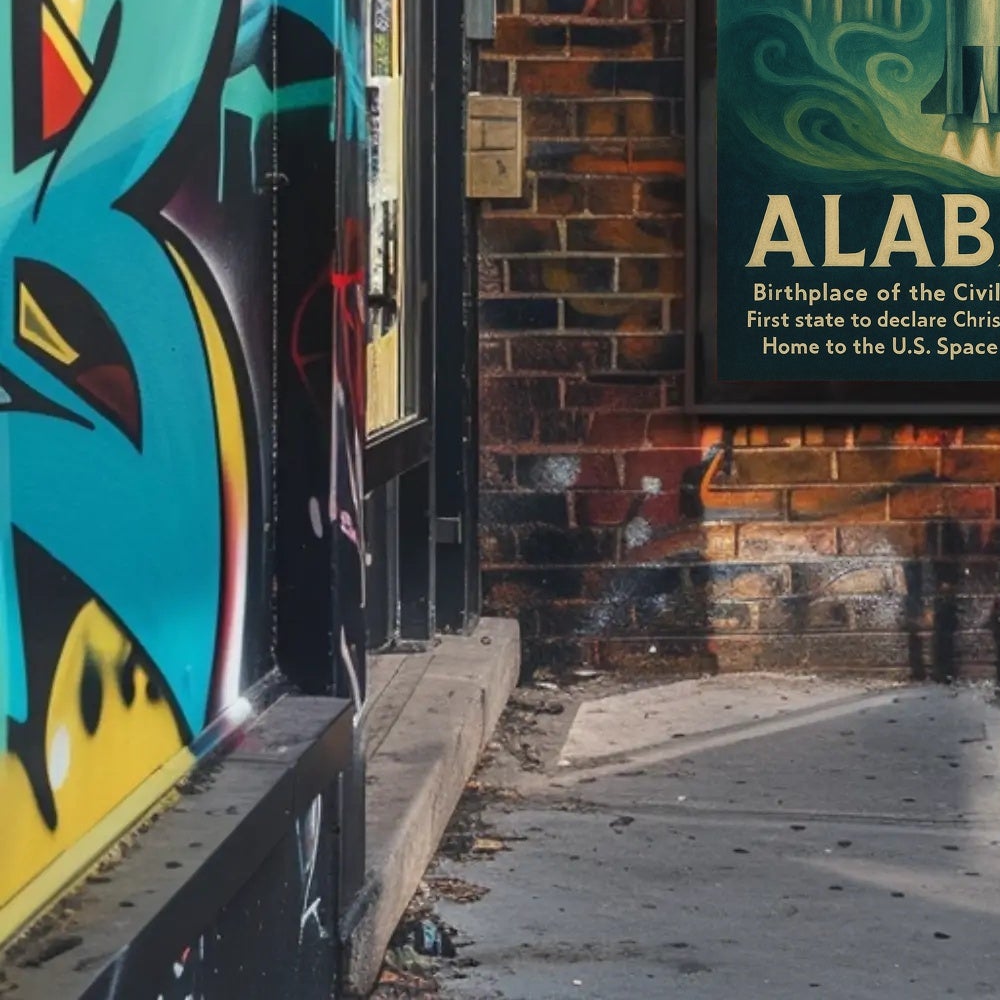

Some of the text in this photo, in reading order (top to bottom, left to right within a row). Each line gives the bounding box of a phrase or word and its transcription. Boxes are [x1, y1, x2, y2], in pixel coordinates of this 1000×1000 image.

[754, 282, 868, 306] Birthplace
[877, 282, 901, 302] of
[908, 282, 946, 302] the
[953, 282, 1000, 302] Civil
[747, 310, 790, 328] First
[795, 312, 845, 328] state
[850, 313, 872, 328] to
[877, 310, 947, 328] declare
[763, 336, 820, 355] Home
[825, 339, 847, 355] to
[852, 336, 885, 355] the
[892, 336, 931, 355] U.S.
[937, 336, 998, 361] Space
